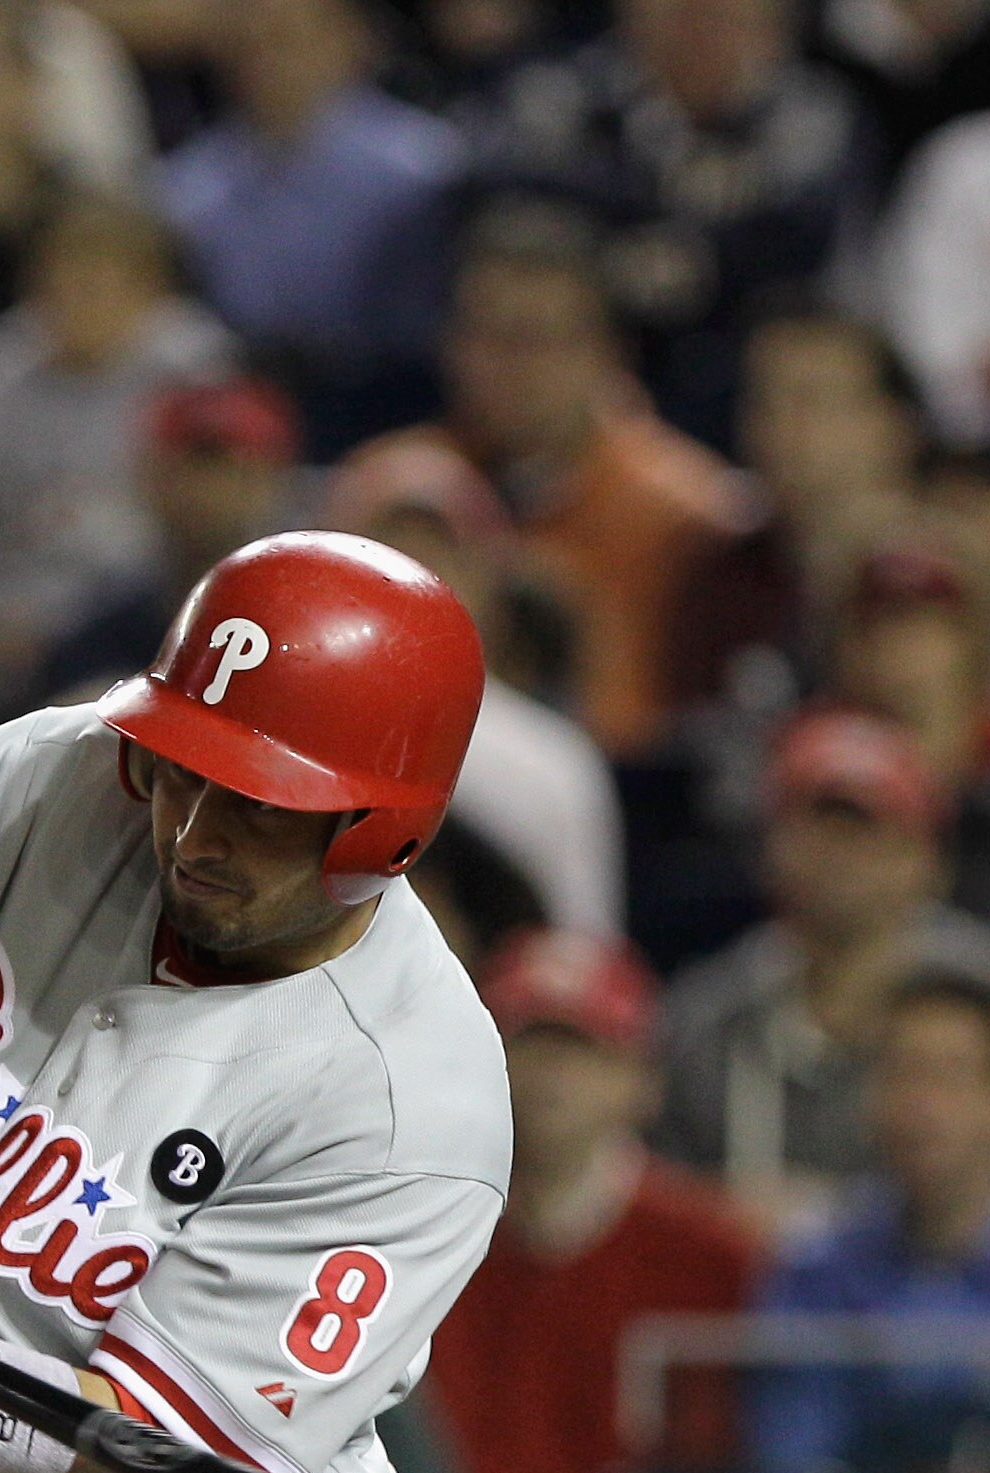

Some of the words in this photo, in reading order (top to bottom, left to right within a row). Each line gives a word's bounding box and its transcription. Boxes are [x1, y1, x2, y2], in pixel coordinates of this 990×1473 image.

[203, 618, 270, 705] P
[168, 1143, 205, 1186] B
[281, 1245, 393, 1382] 8
